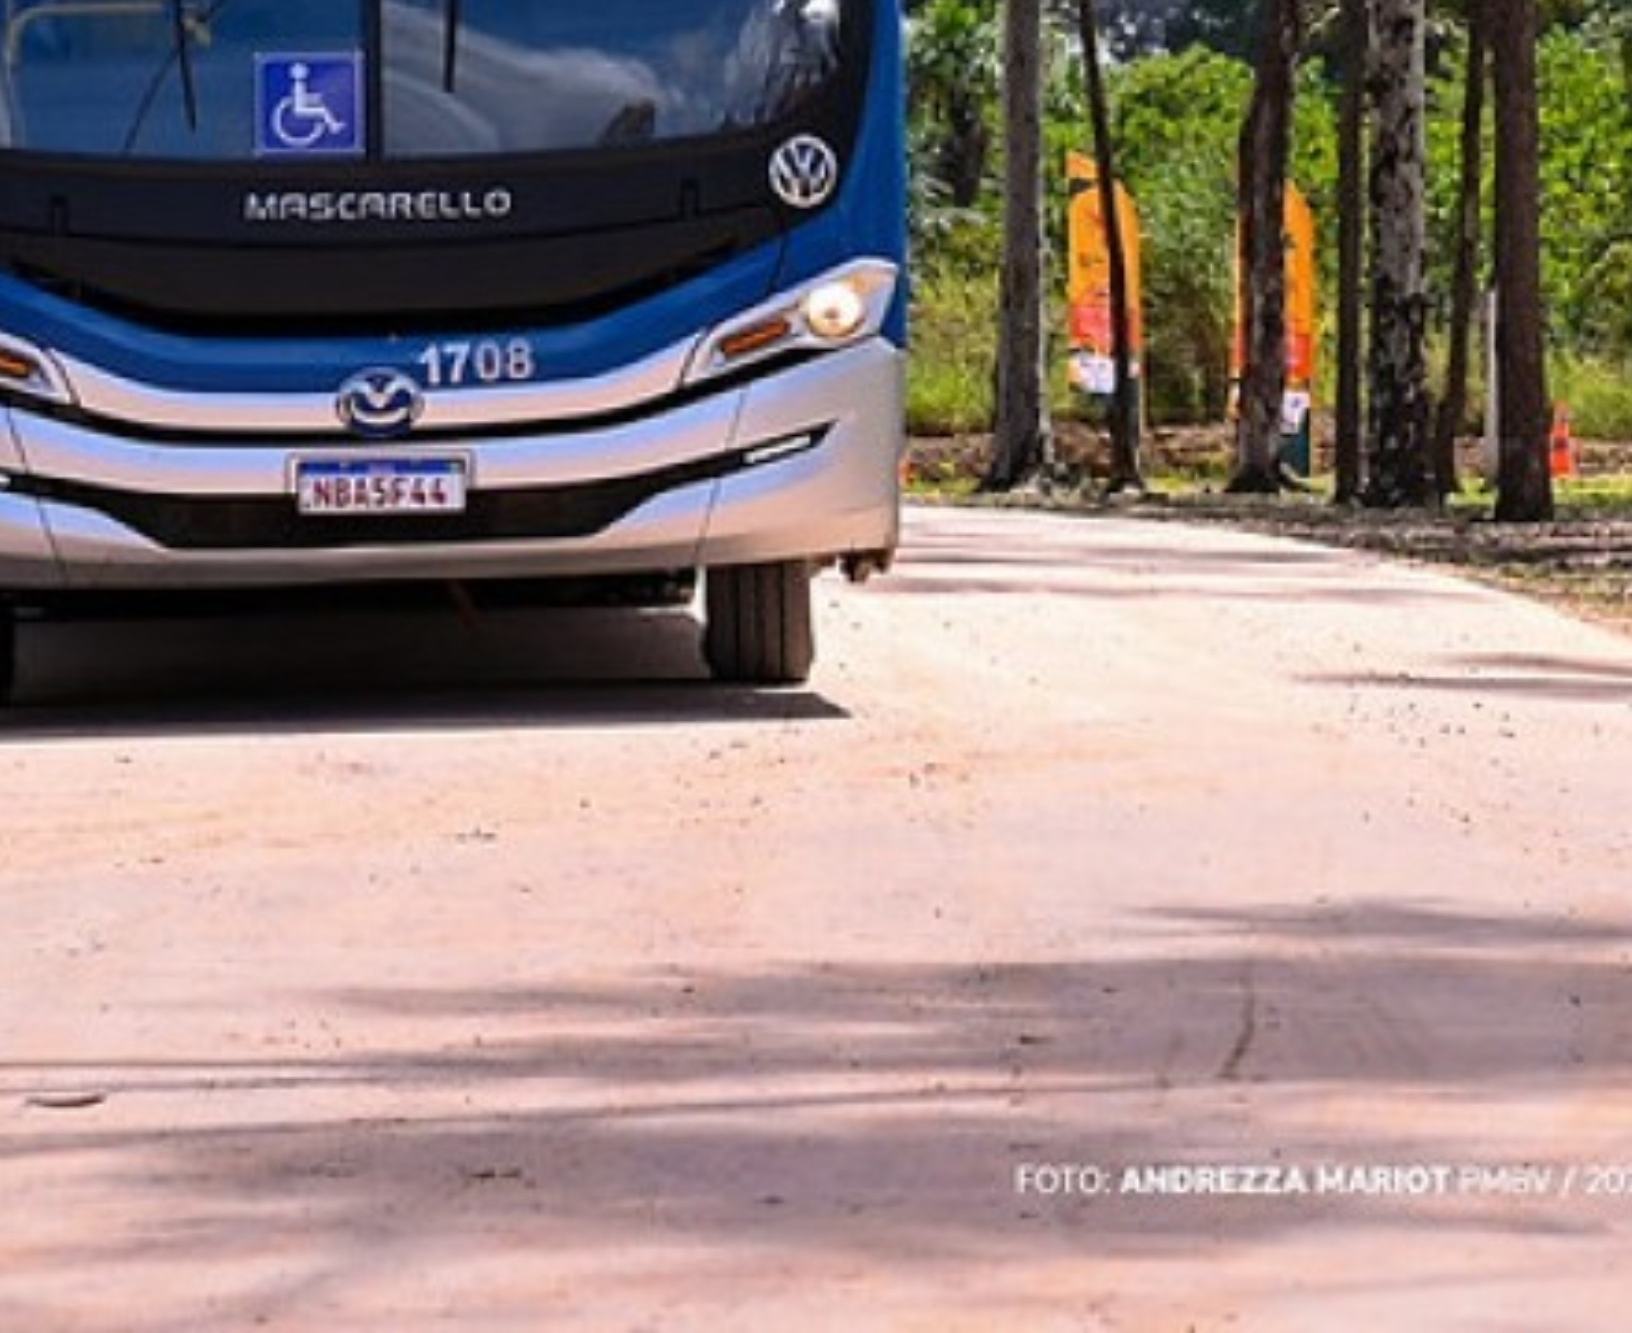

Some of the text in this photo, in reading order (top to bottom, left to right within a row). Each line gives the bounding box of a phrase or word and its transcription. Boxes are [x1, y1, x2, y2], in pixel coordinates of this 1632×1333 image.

[243, 190, 513, 220] MASCARELLO
[419, 337, 535, 384] 1708
[313, 476, 447, 508] NBA5F44
